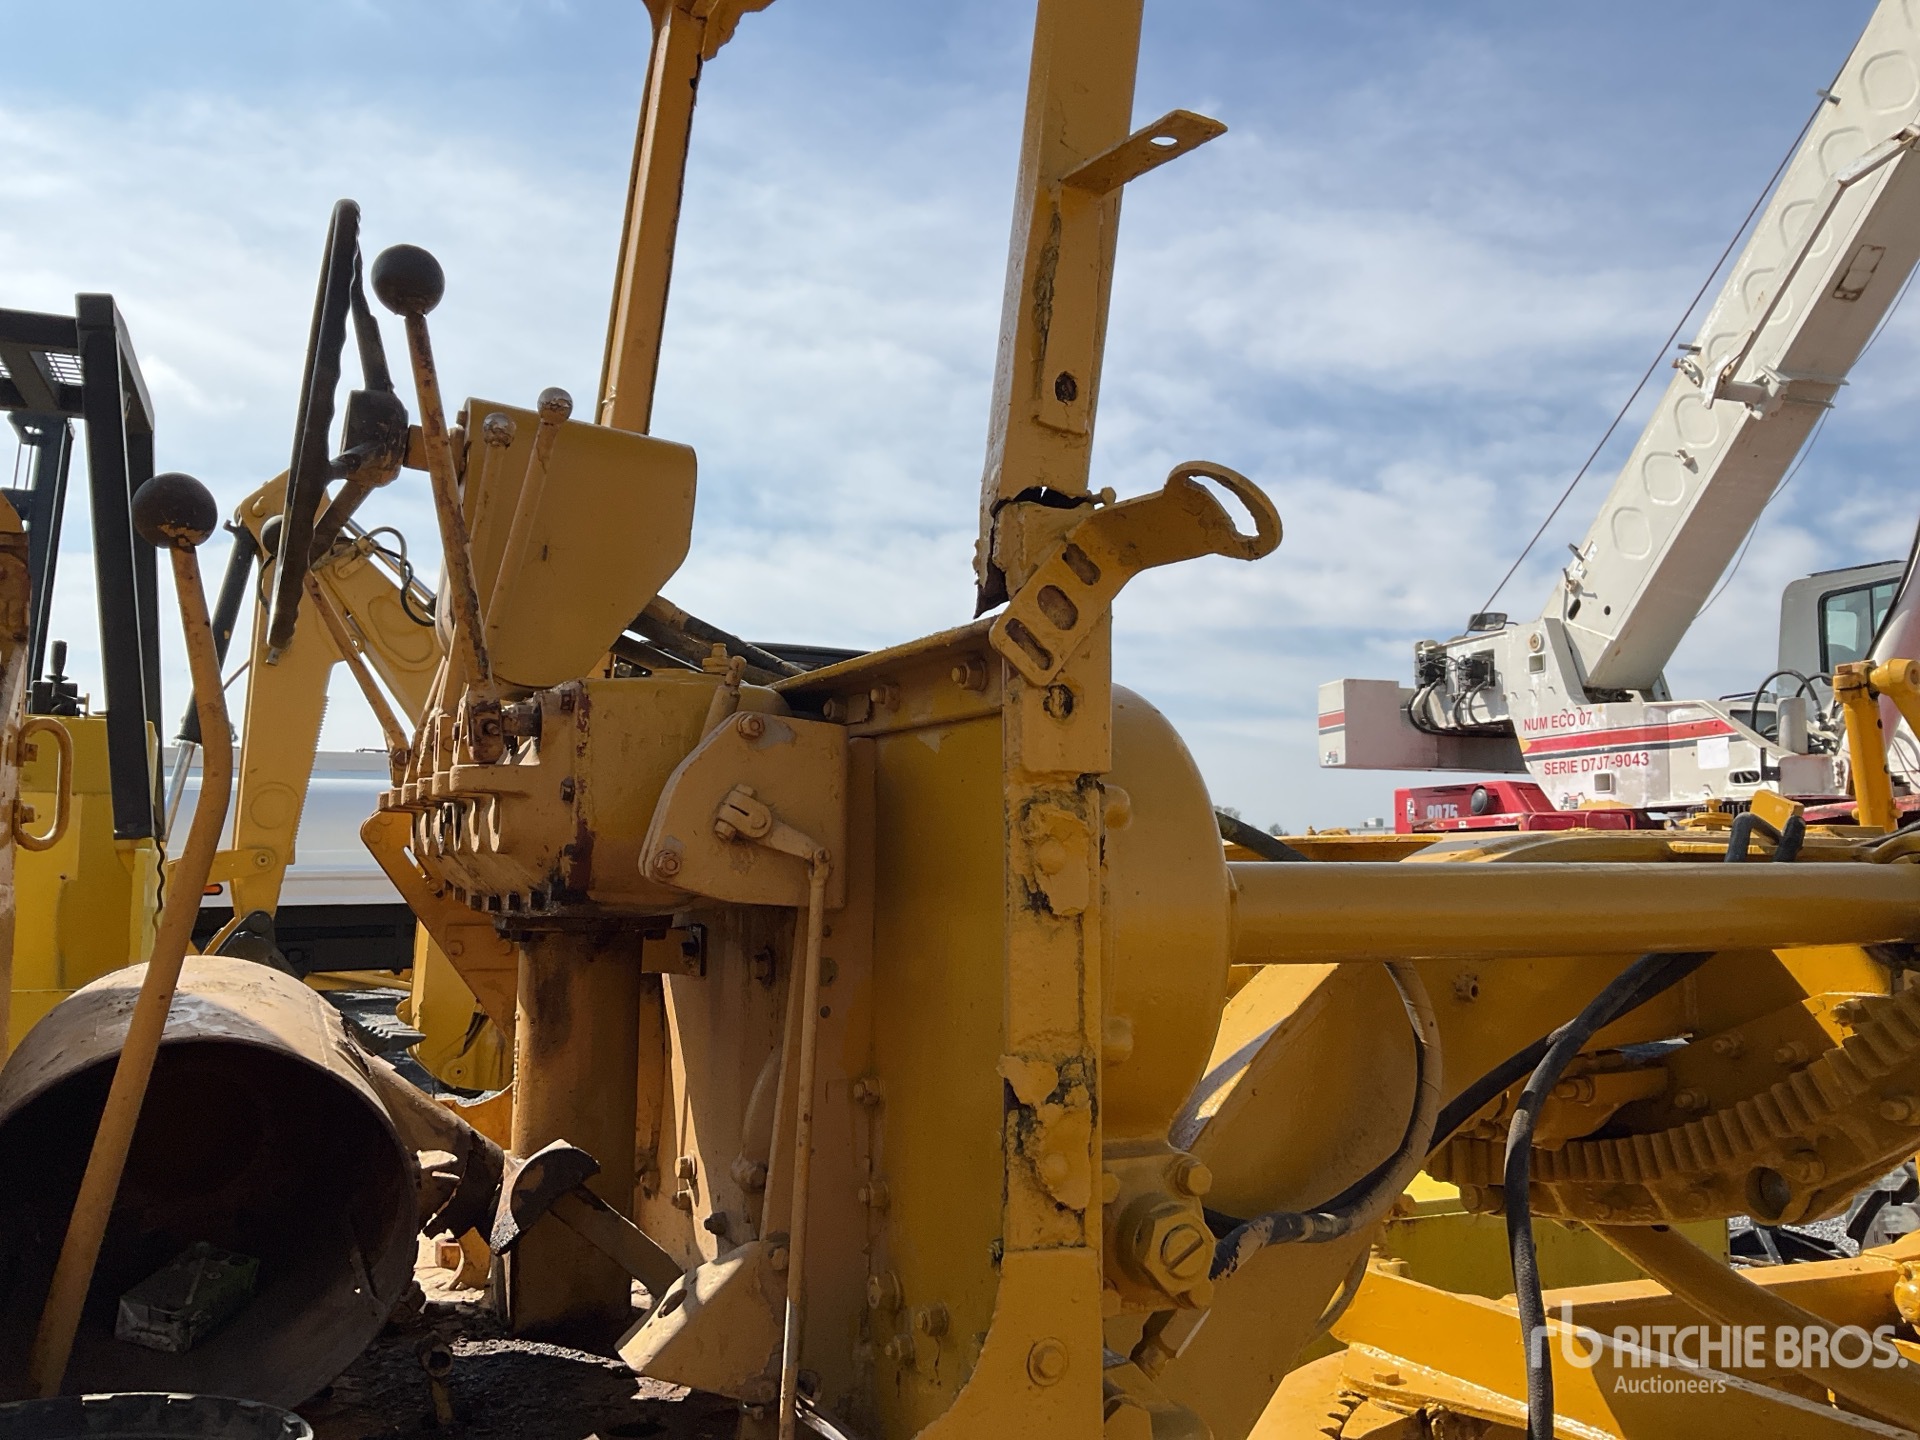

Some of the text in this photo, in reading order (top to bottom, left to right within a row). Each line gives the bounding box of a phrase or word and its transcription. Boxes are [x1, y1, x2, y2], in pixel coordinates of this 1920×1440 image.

[1524, 711, 1592, 731] NUM ECO 07
[1544, 752, 1649, 775] SERIE D7J7-9043
